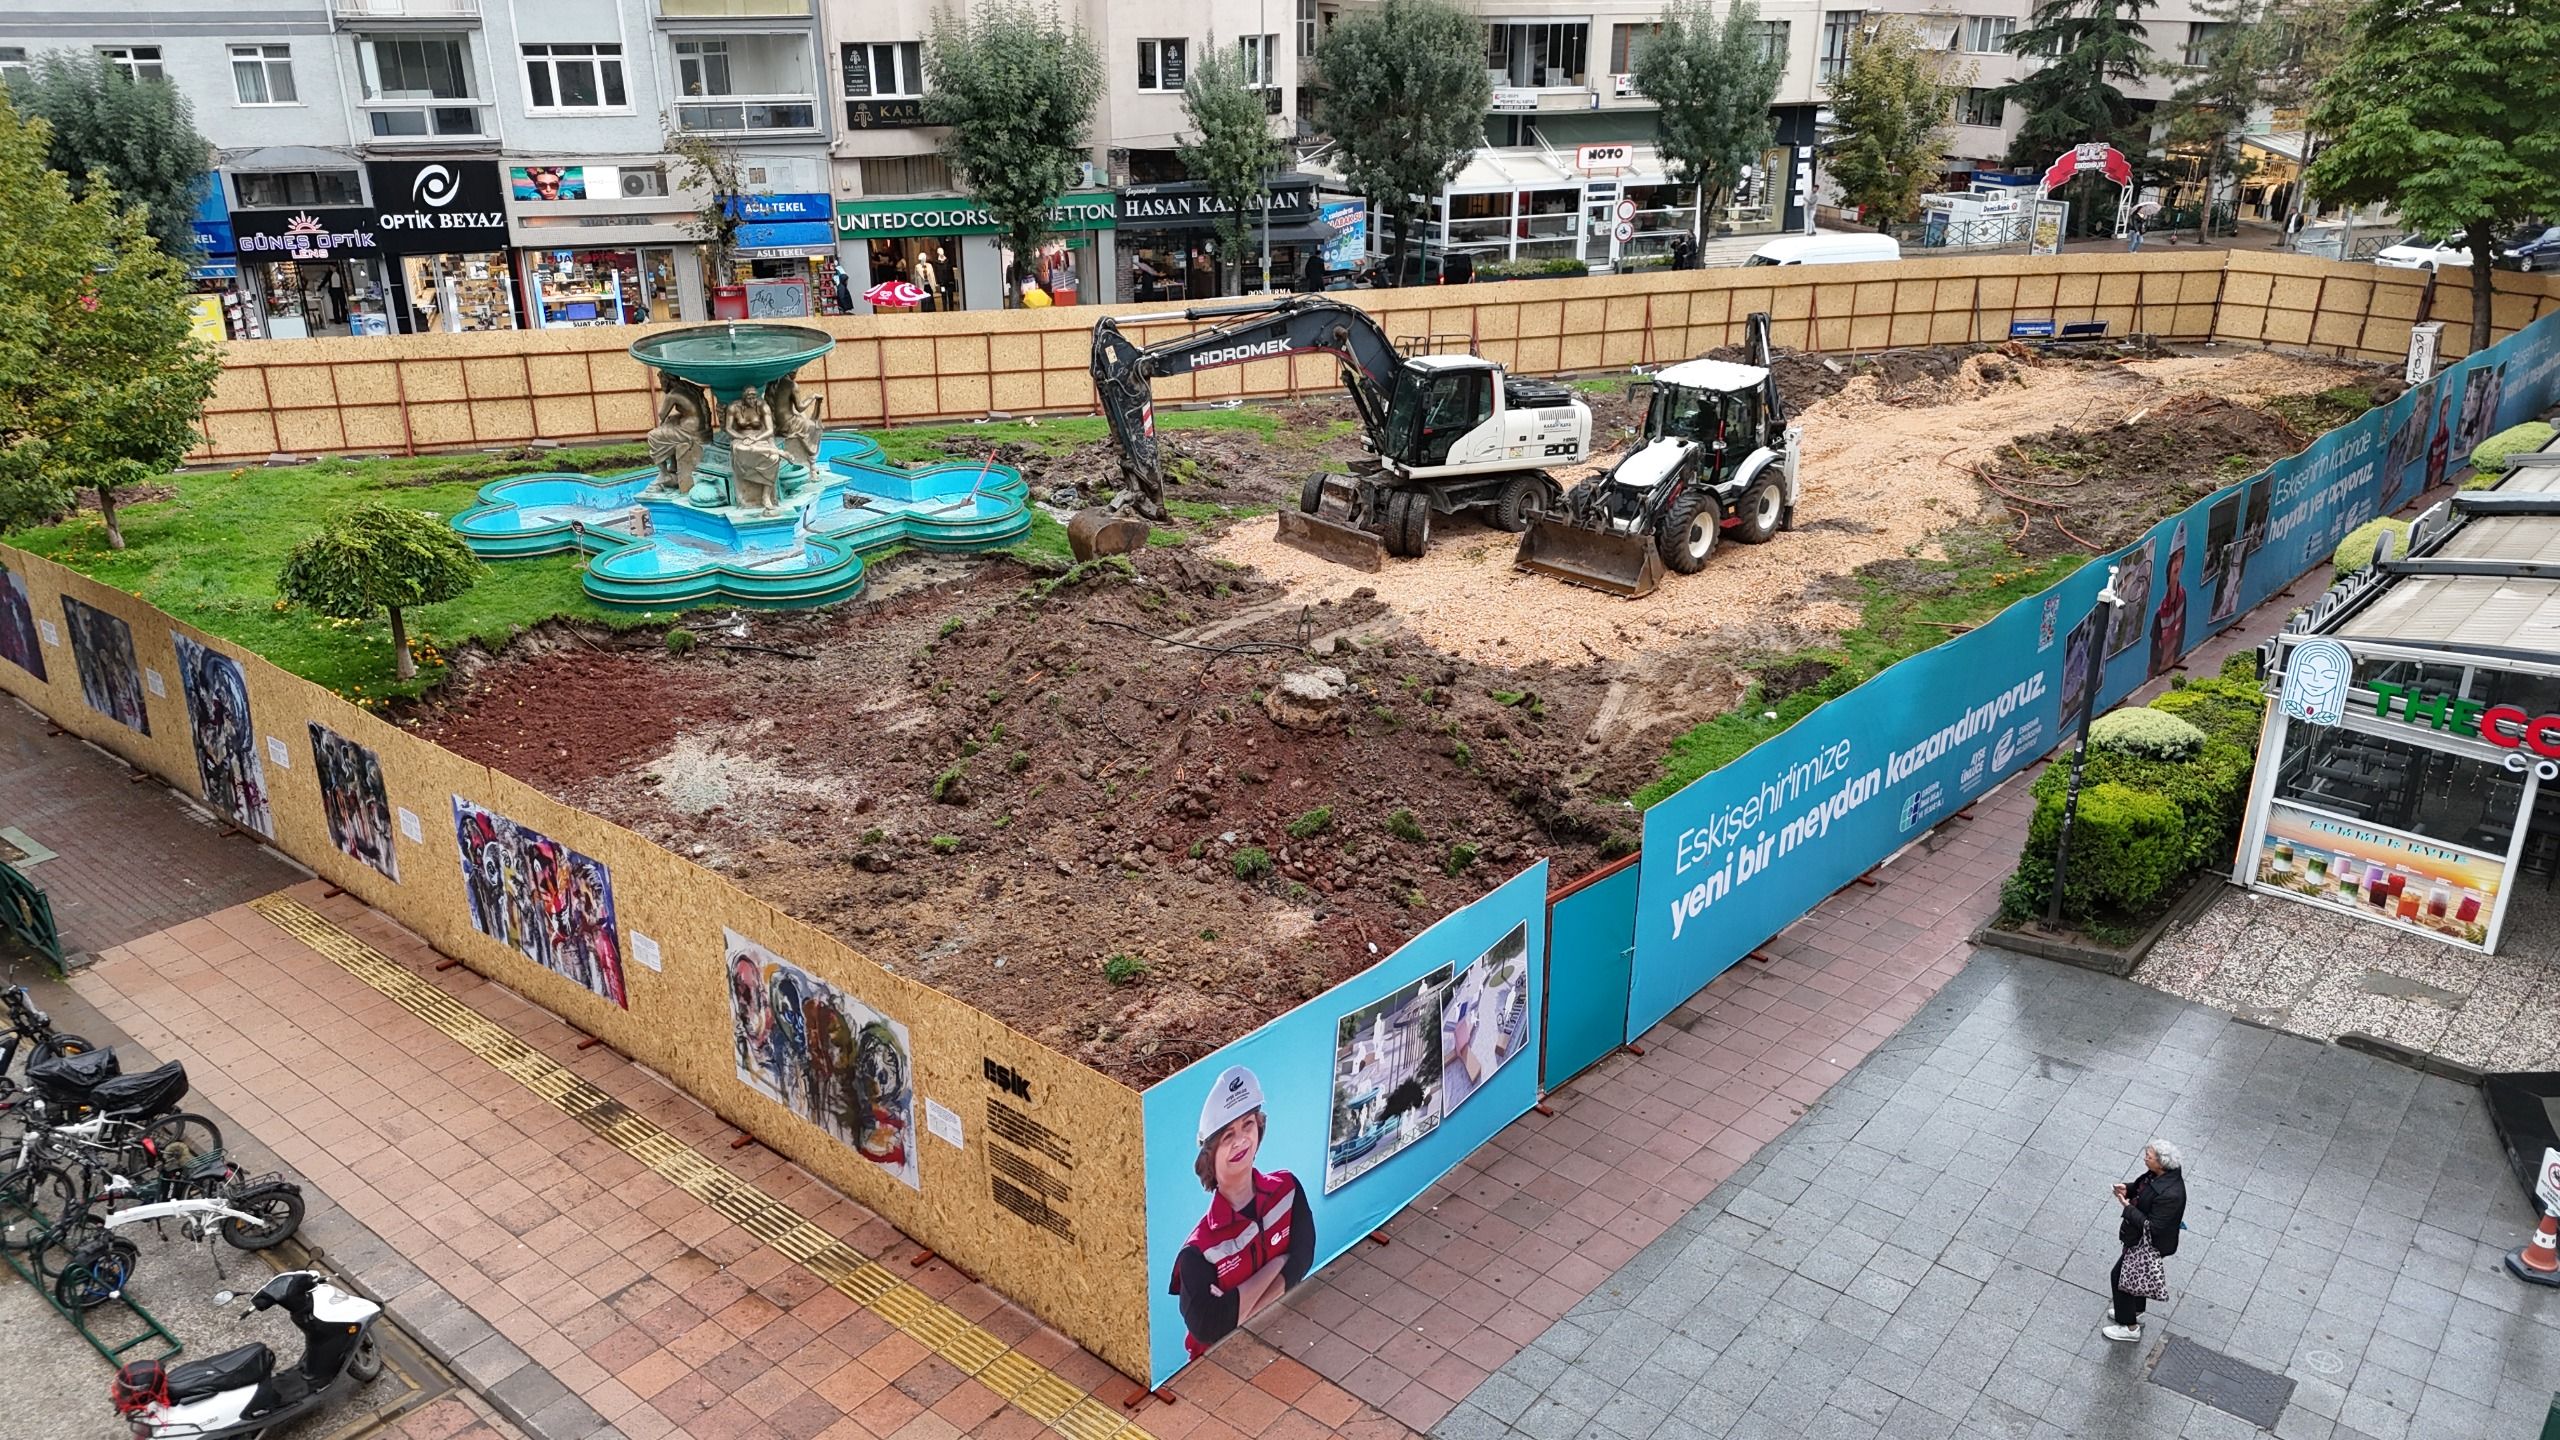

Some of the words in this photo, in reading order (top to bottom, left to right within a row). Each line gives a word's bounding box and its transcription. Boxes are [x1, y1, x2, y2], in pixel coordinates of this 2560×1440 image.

[772, 202, 807, 212] TEKEL
[1125, 198, 1191, 217] HASAN
[380, 210, 435, 229] OPTİK
[438, 212, 504, 228] BEYAZ
[837, 212, 908, 232] UNITED
[910, 209, 987, 228] COLORS
[239, 232, 311, 251] GÜNEŞ
[317, 229, 377, 248] OPTİK
[291, 249, 329, 259] LENS
[757, 249, 776, 258] ASLI
[778, 248, 805, 257] TEKEL
[1247, 287, 1293, 296] DONURMA
[1544, 442, 1579, 457] 200
[2308, 486, 2329, 523] yer
[1671, 842, 1732, 941] yeni
[1738, 829, 1771, 887] bir
[1779, 769, 1882, 861] meydan
